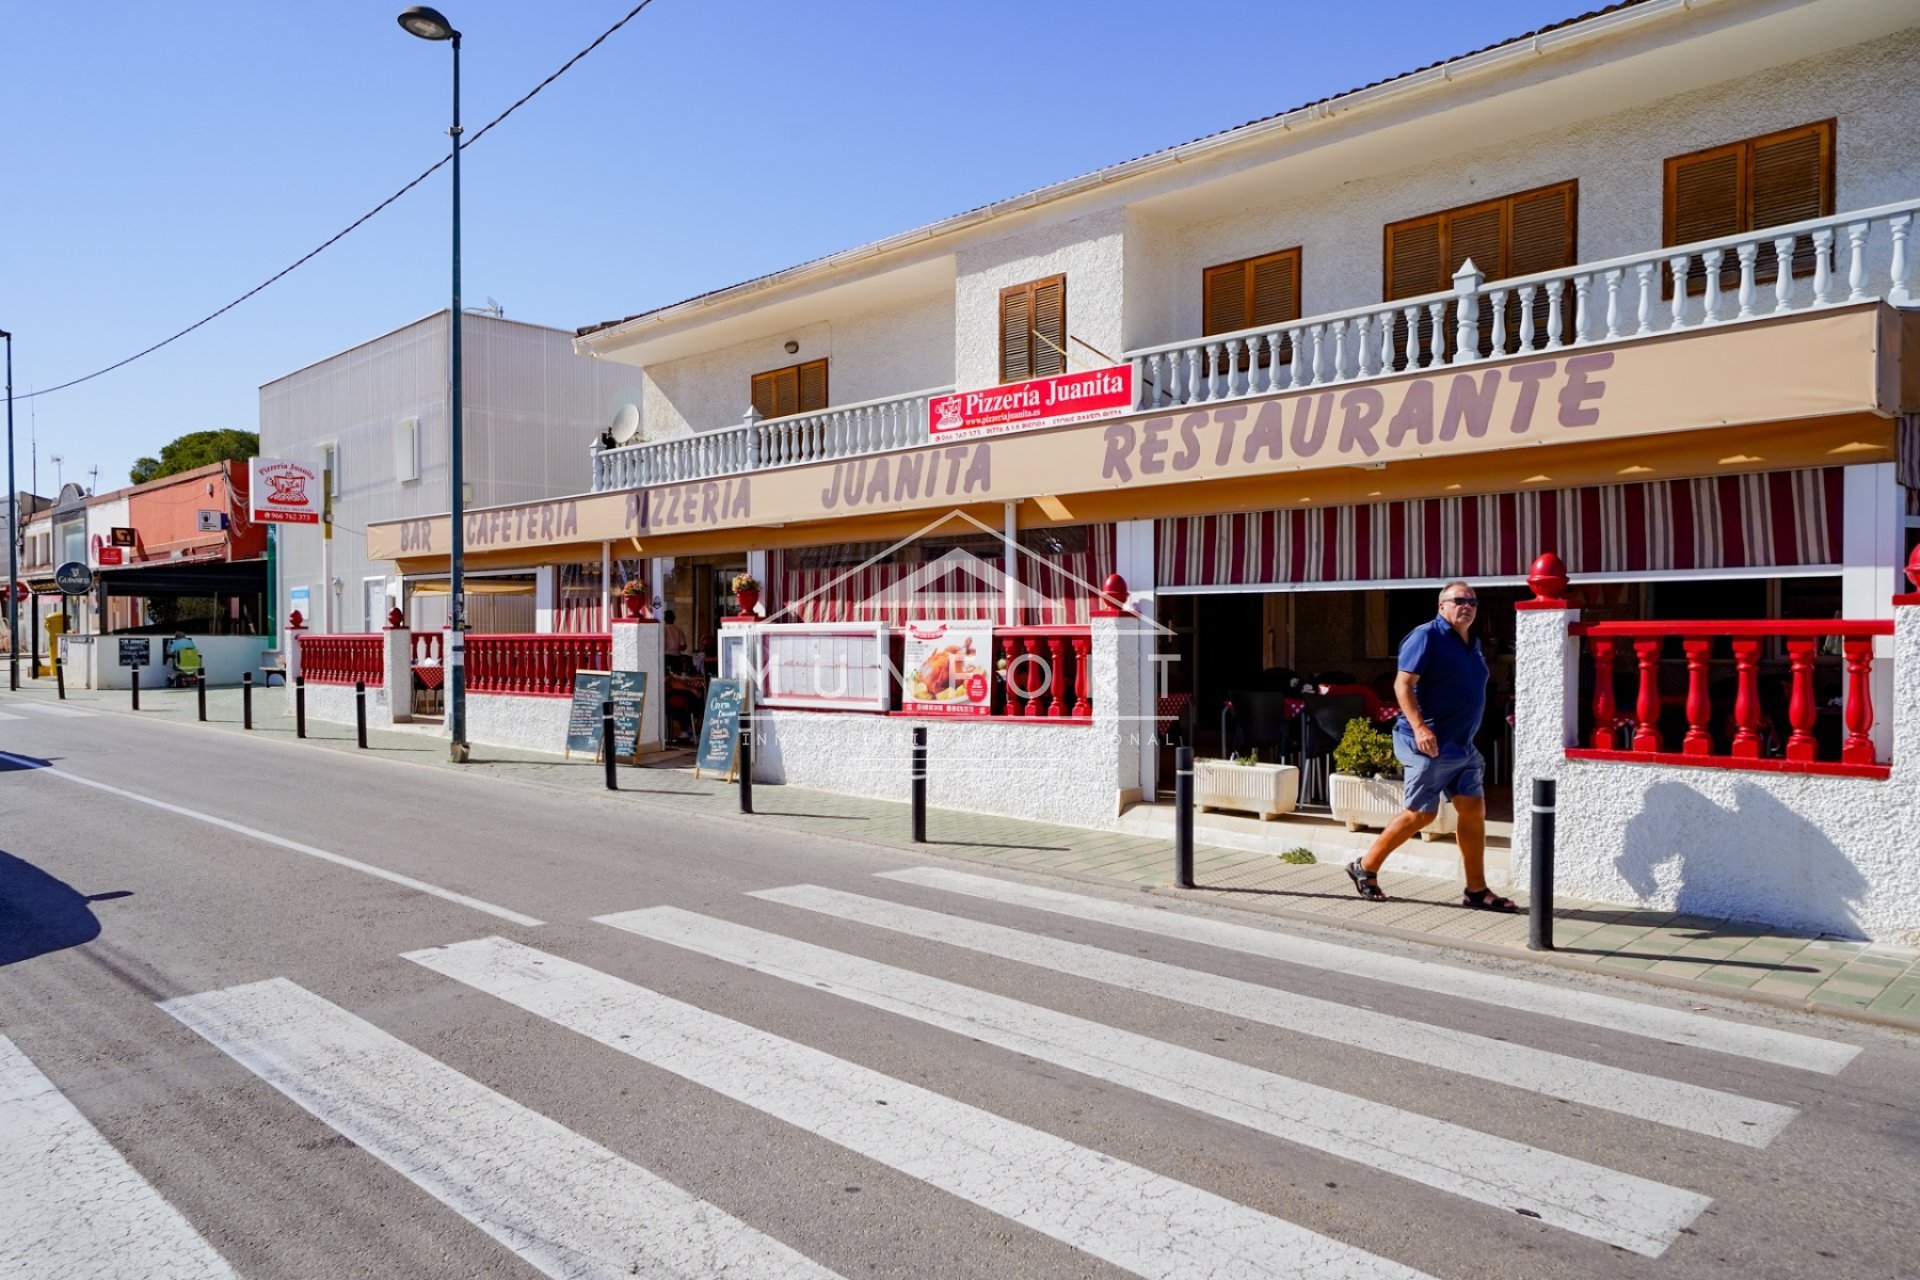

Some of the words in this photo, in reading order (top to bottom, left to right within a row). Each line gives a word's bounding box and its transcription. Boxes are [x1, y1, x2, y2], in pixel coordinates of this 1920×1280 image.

[966, 383, 1040, 416] Pizzería
[1045, 374, 1124, 406] Juanita
[1102, 352, 1615, 483] RESTAURANTE
[290, 463, 316, 480] Juanita
[821, 442, 992, 510] JUANITA
[400, 520, 432, 553] BAR
[466, 501, 578, 546] CAFETERIA
[625, 477, 751, 530] PIZZERIA
